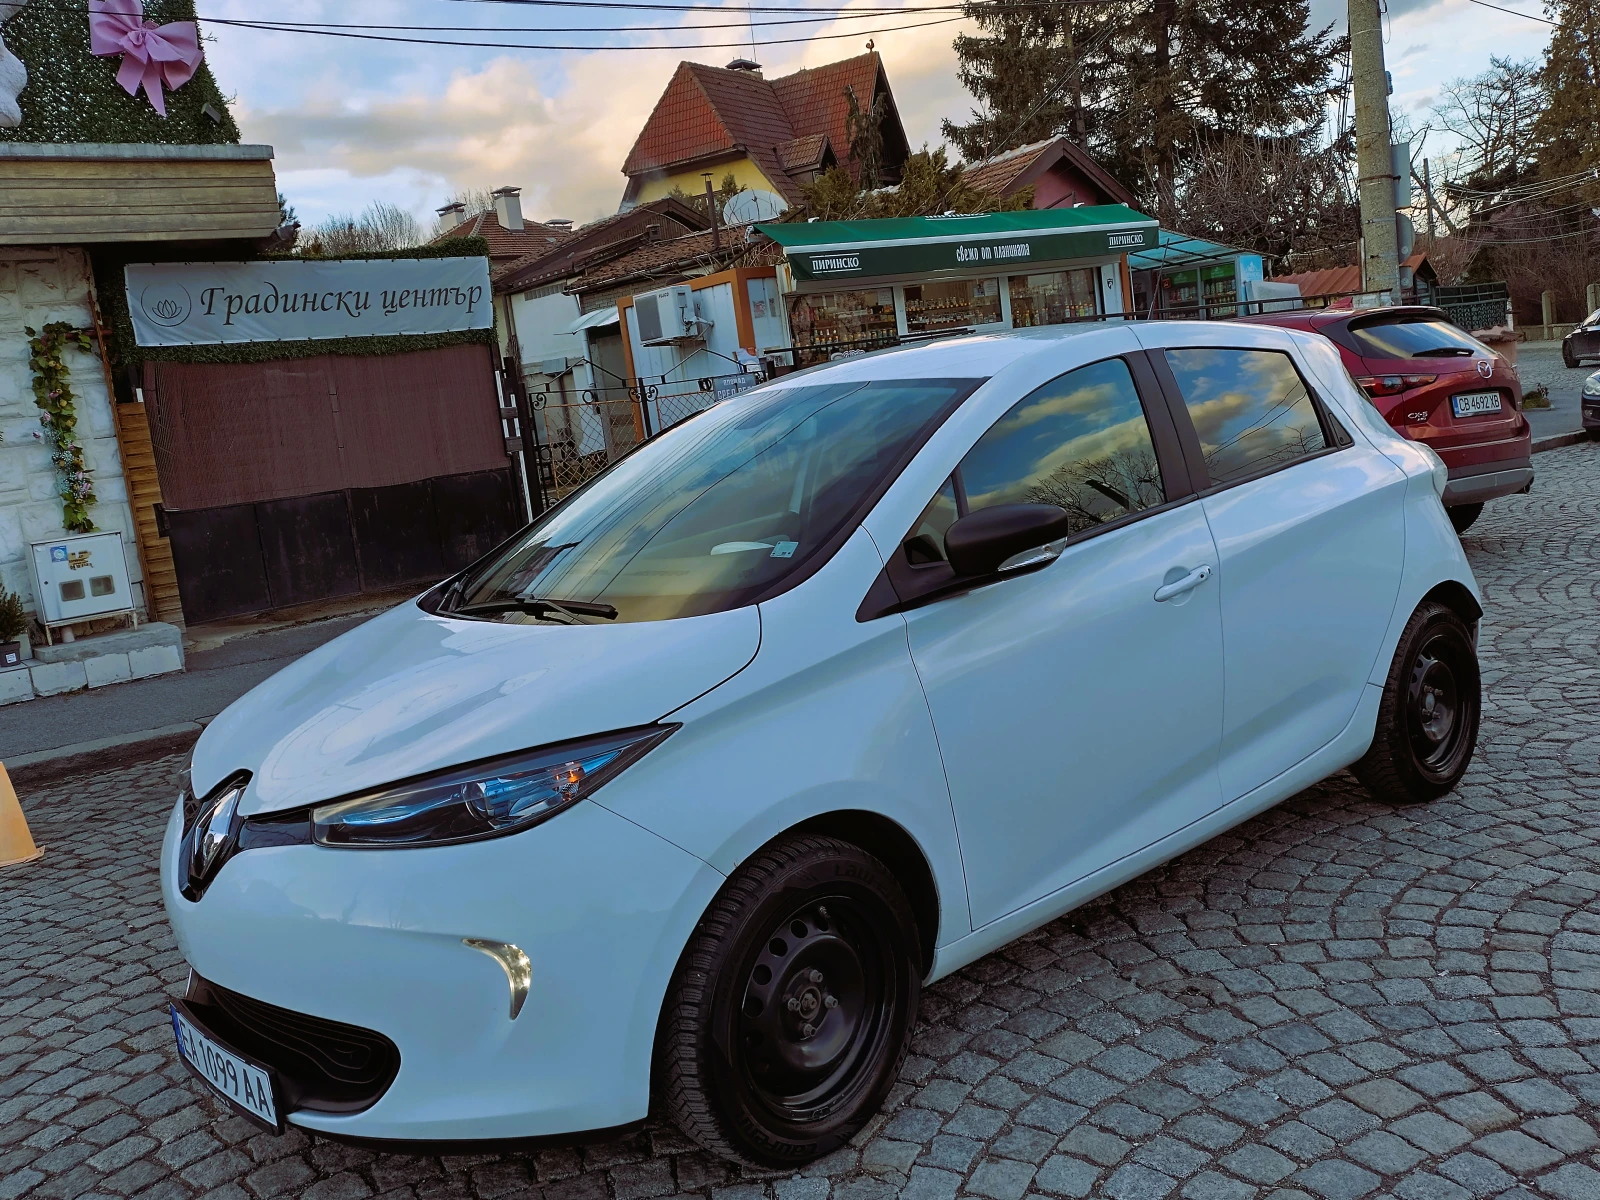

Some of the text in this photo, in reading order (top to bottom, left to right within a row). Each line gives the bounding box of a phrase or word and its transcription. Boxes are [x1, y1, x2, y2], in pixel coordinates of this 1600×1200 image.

[1108, 234, 1144, 246] ПИРИНСКО
[956, 243, 1031, 261] свежо от планината
[811, 257, 860, 270] ПИРИНСКО
[200, 281, 483, 325] Градински център
[1458, 395, 1500, 411] CB 4692 XB
[198, 1039, 239, 1097] 1099
[242, 1068, 272, 1117] AA
